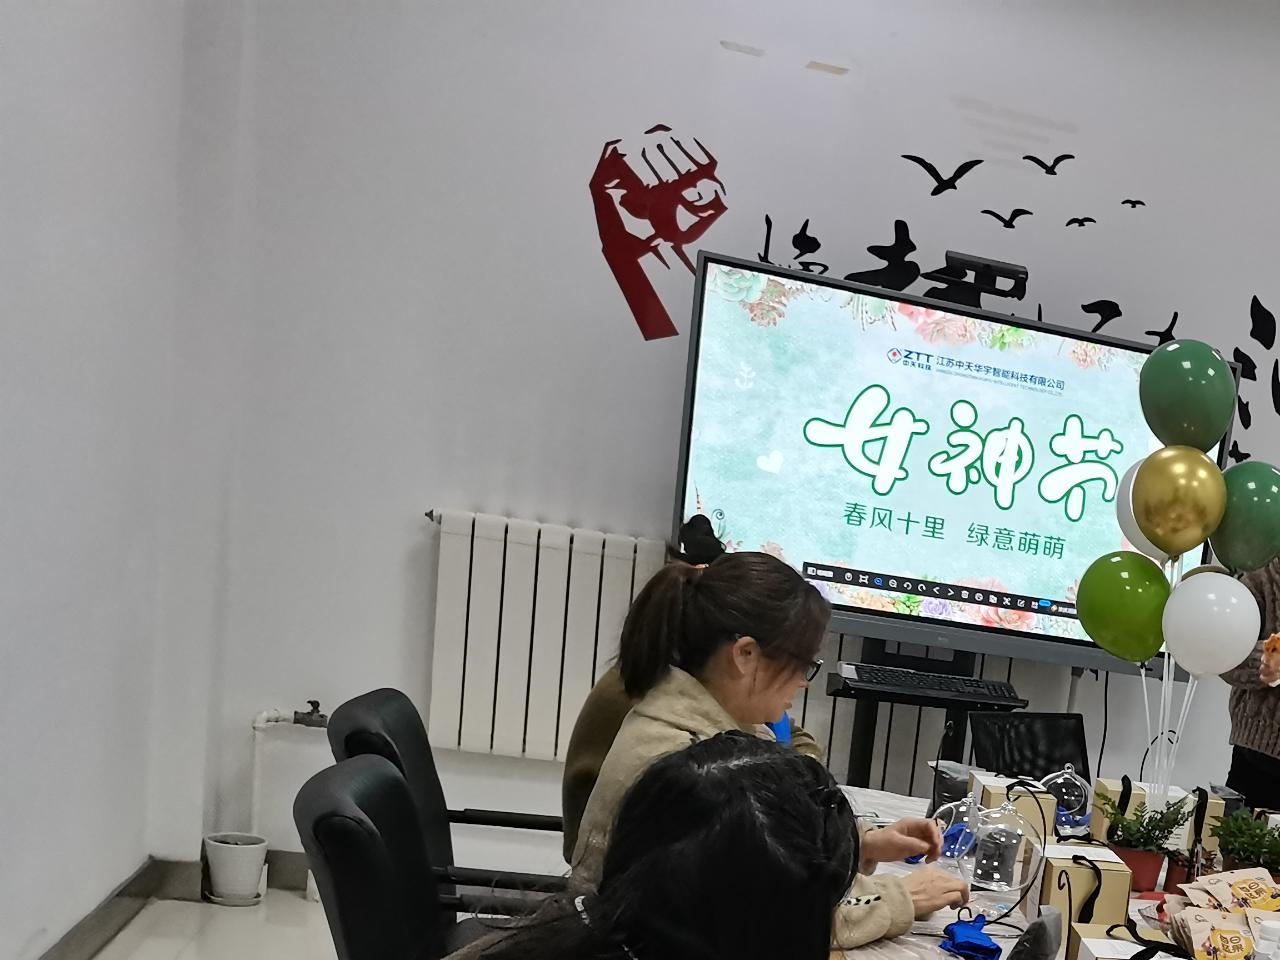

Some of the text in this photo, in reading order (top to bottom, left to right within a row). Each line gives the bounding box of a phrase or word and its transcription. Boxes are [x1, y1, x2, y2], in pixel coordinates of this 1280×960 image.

[904, 349, 934, 363] ZTT
[936, 355, 1065, 391] 江苏中天华宇智能科技有限公司
[803, 384, 1124, 522] 女神节
[843, 502, 1067, 560] 春风十里 绿意萌萌
